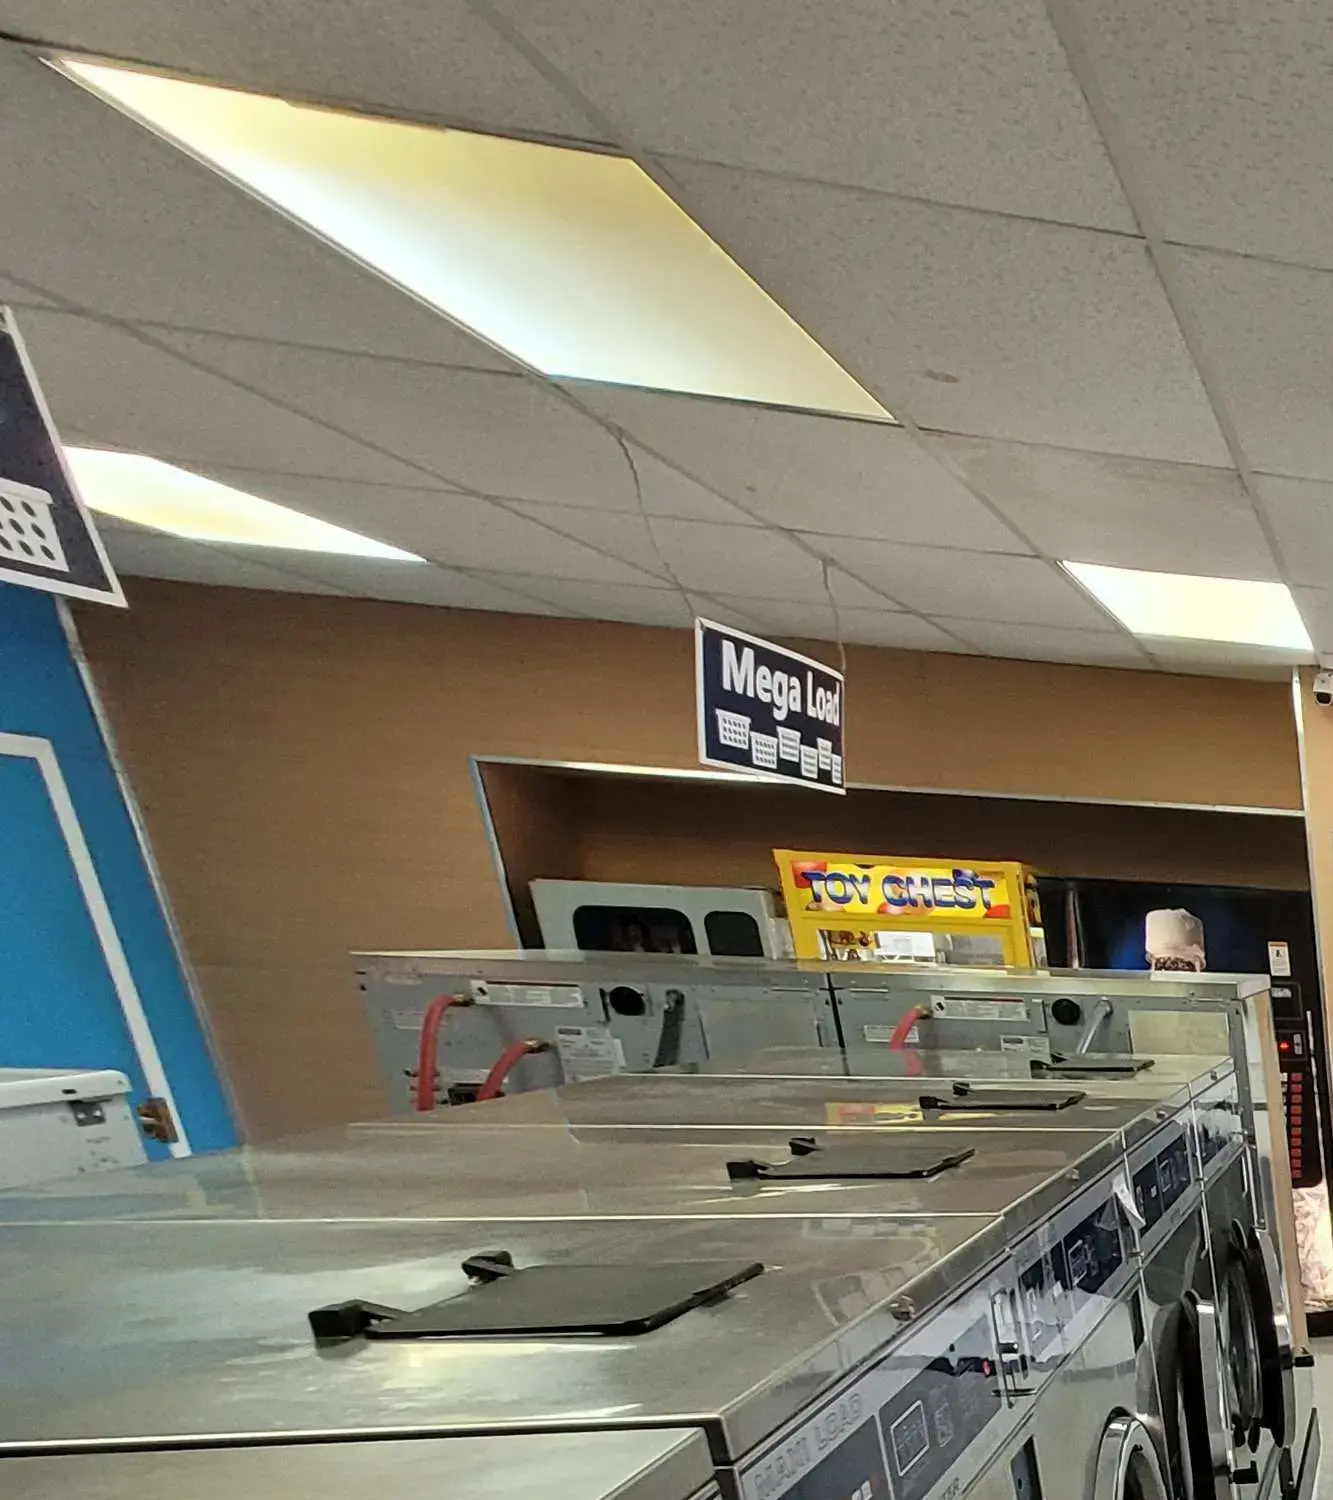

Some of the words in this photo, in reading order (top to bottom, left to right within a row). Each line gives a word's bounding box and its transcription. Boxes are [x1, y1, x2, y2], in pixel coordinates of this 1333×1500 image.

[721, 639, 802, 721] Mega
[806, 671, 840, 726] Load
[802, 870, 872, 905] TOY
[881, 873, 996, 910] CHEST
